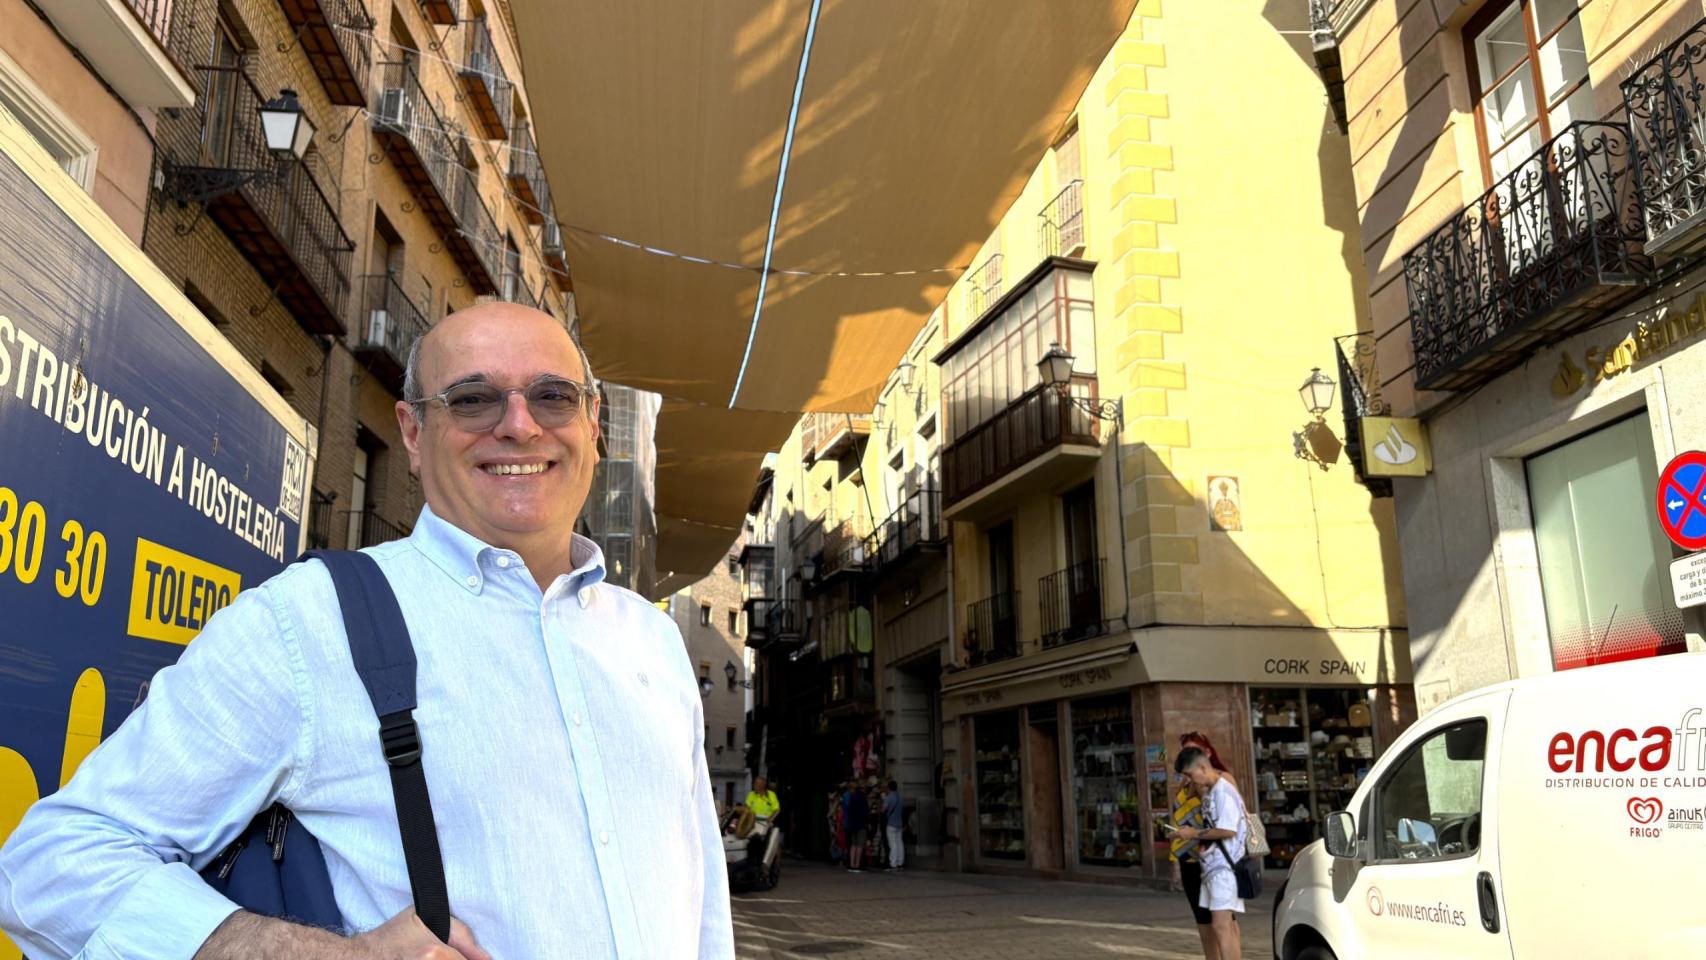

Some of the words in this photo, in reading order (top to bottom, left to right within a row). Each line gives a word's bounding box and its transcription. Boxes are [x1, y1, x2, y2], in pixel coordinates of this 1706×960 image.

[167, 444, 185, 500] A
[188, 456, 286, 564] HOSTELERÍA
[55, 519, 107, 606] 30
[1264, 658, 1309, 674] CORK
[1320, 660, 1365, 675] SPAIN
[1546, 778, 1634, 788] DISTRIBUCION
[1640, 778, 1657, 788] DE
[1630, 827, 1660, 838] FRIGO
[1386, 901, 1466, 926] www.encafri.es
